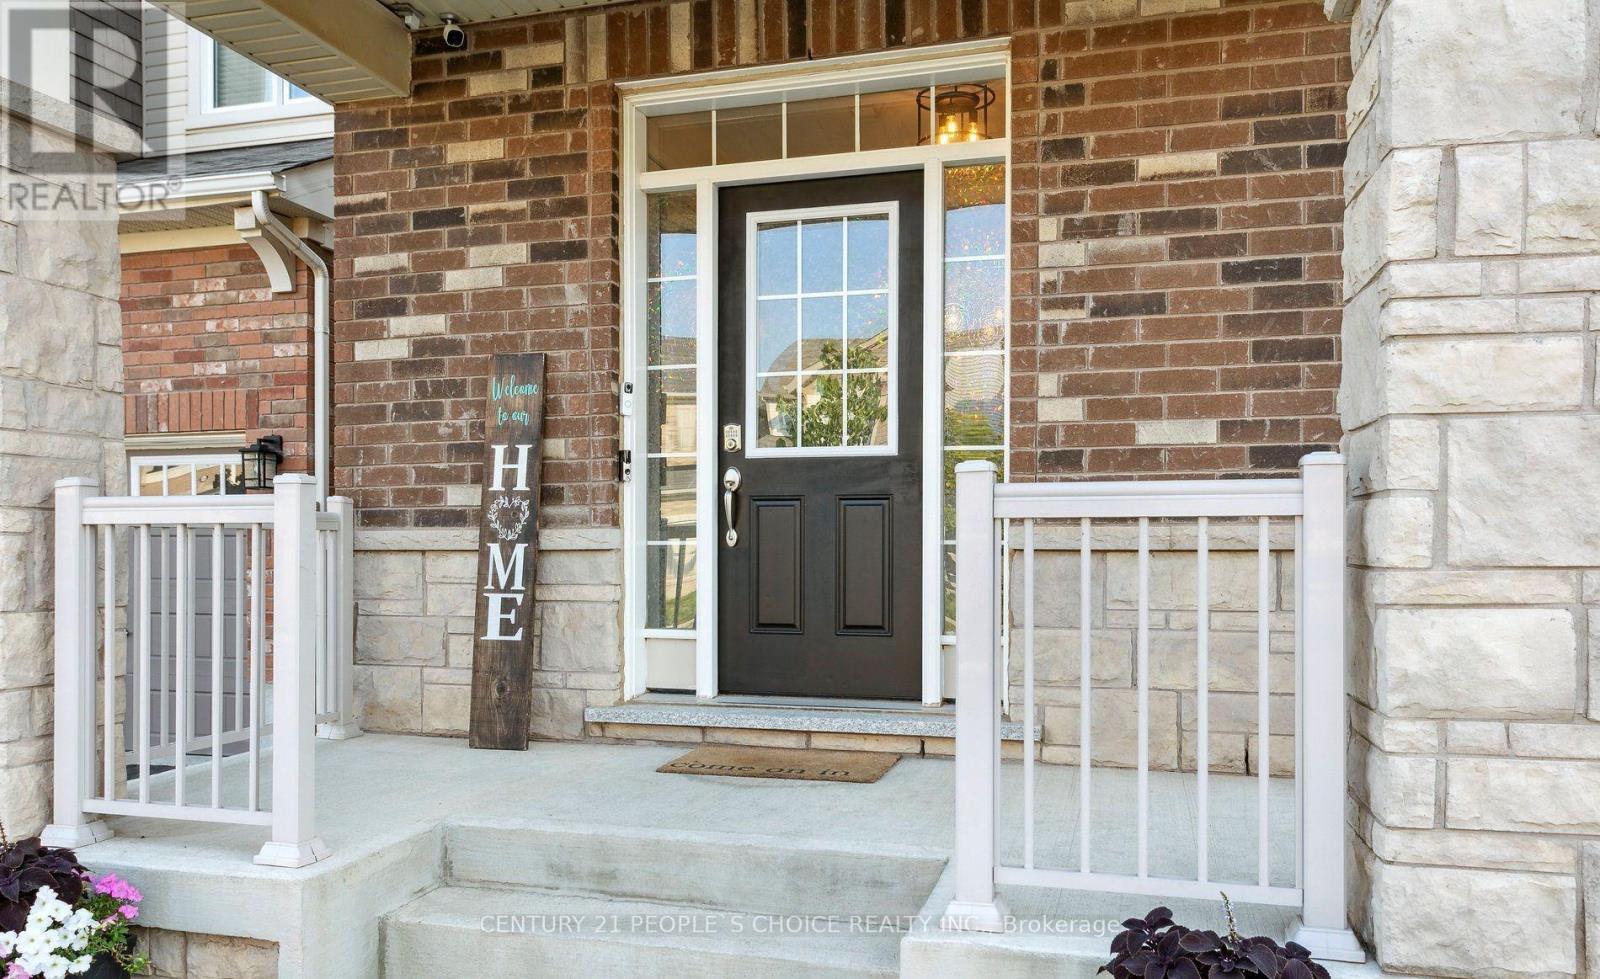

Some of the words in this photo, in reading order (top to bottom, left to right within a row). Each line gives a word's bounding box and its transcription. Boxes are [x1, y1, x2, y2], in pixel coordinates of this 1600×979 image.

[492, 375, 539, 400] Welcome
[498, 407, 508, 425] to
[512, 411, 529, 425] our
